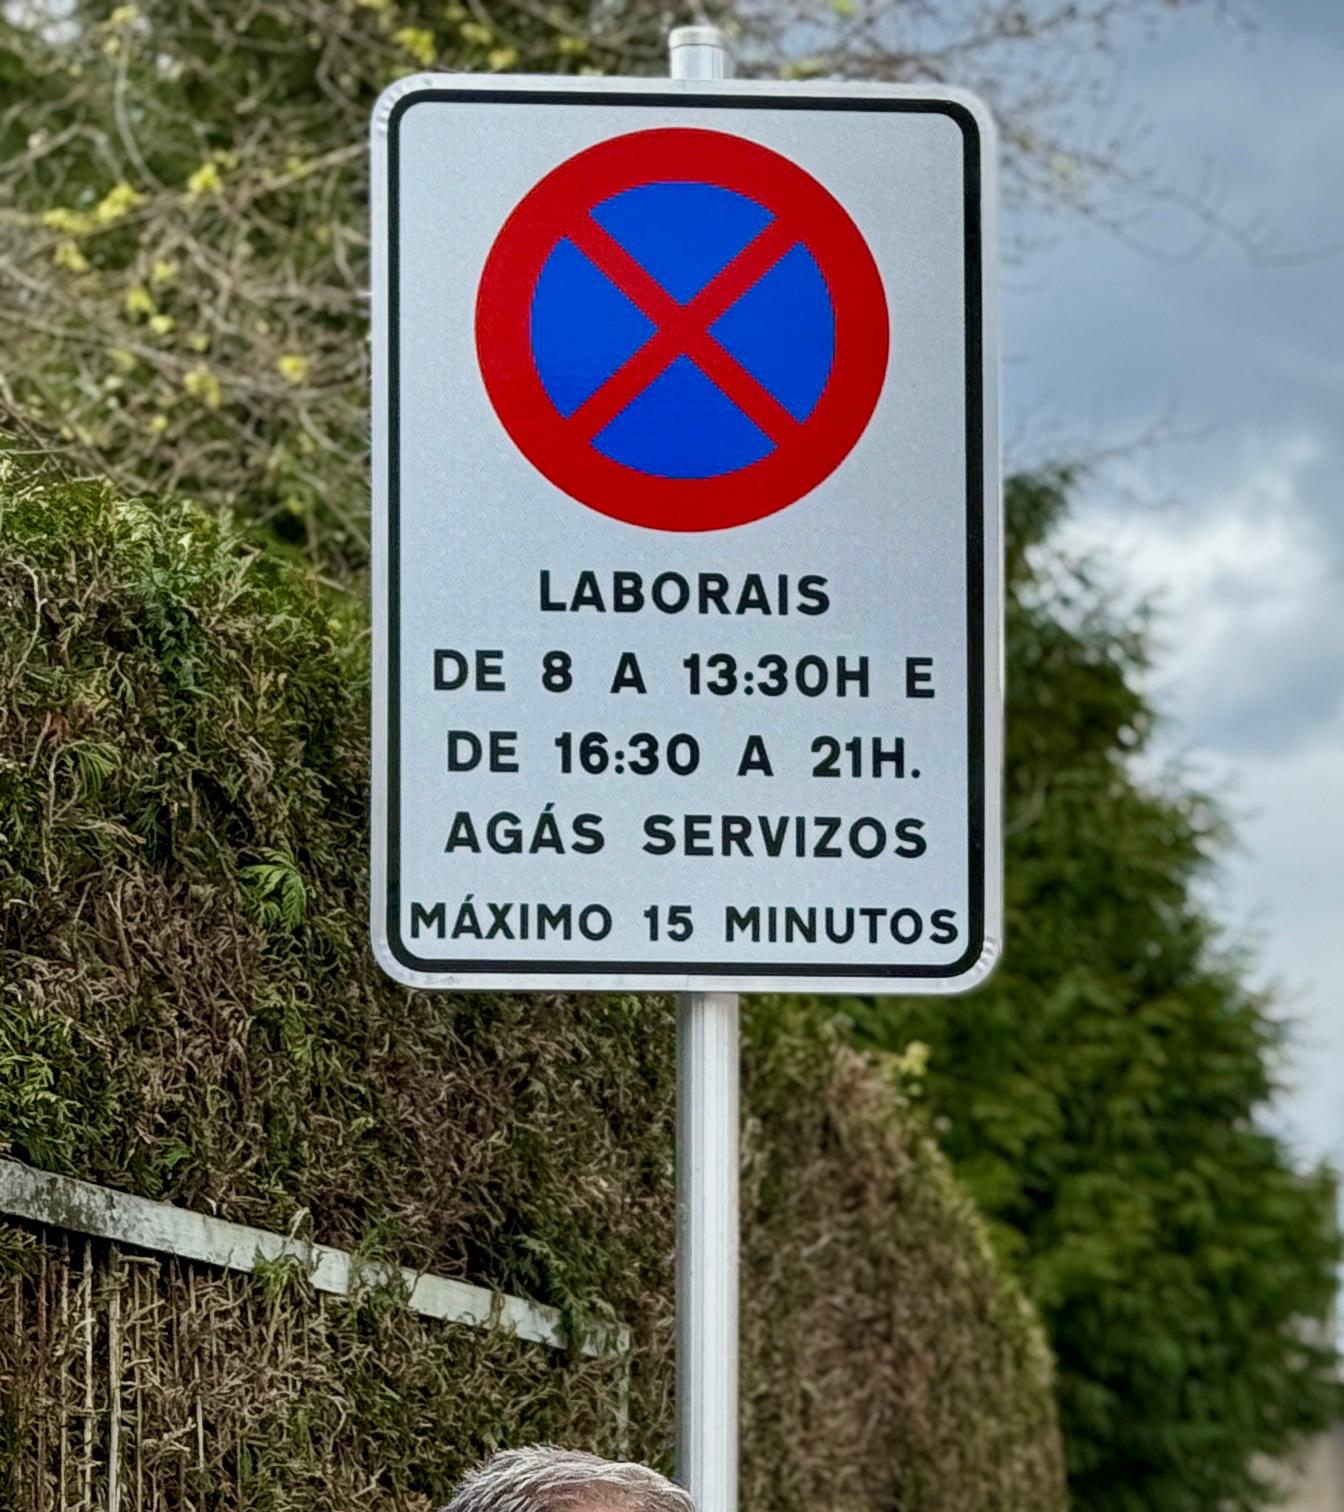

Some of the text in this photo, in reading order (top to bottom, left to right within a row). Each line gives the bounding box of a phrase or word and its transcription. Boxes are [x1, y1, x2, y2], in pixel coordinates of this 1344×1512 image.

[540, 570, 830, 616] LABORAIS
[433, 649, 935, 699] DE 8 A 13:30H E
[447, 730, 921, 779] DE 16:30 A 21H.
[444, 802, 927, 859] AGÁS SERVIZOS
[410, 893, 959, 945] MÁXIMO 15 MINUTOS
